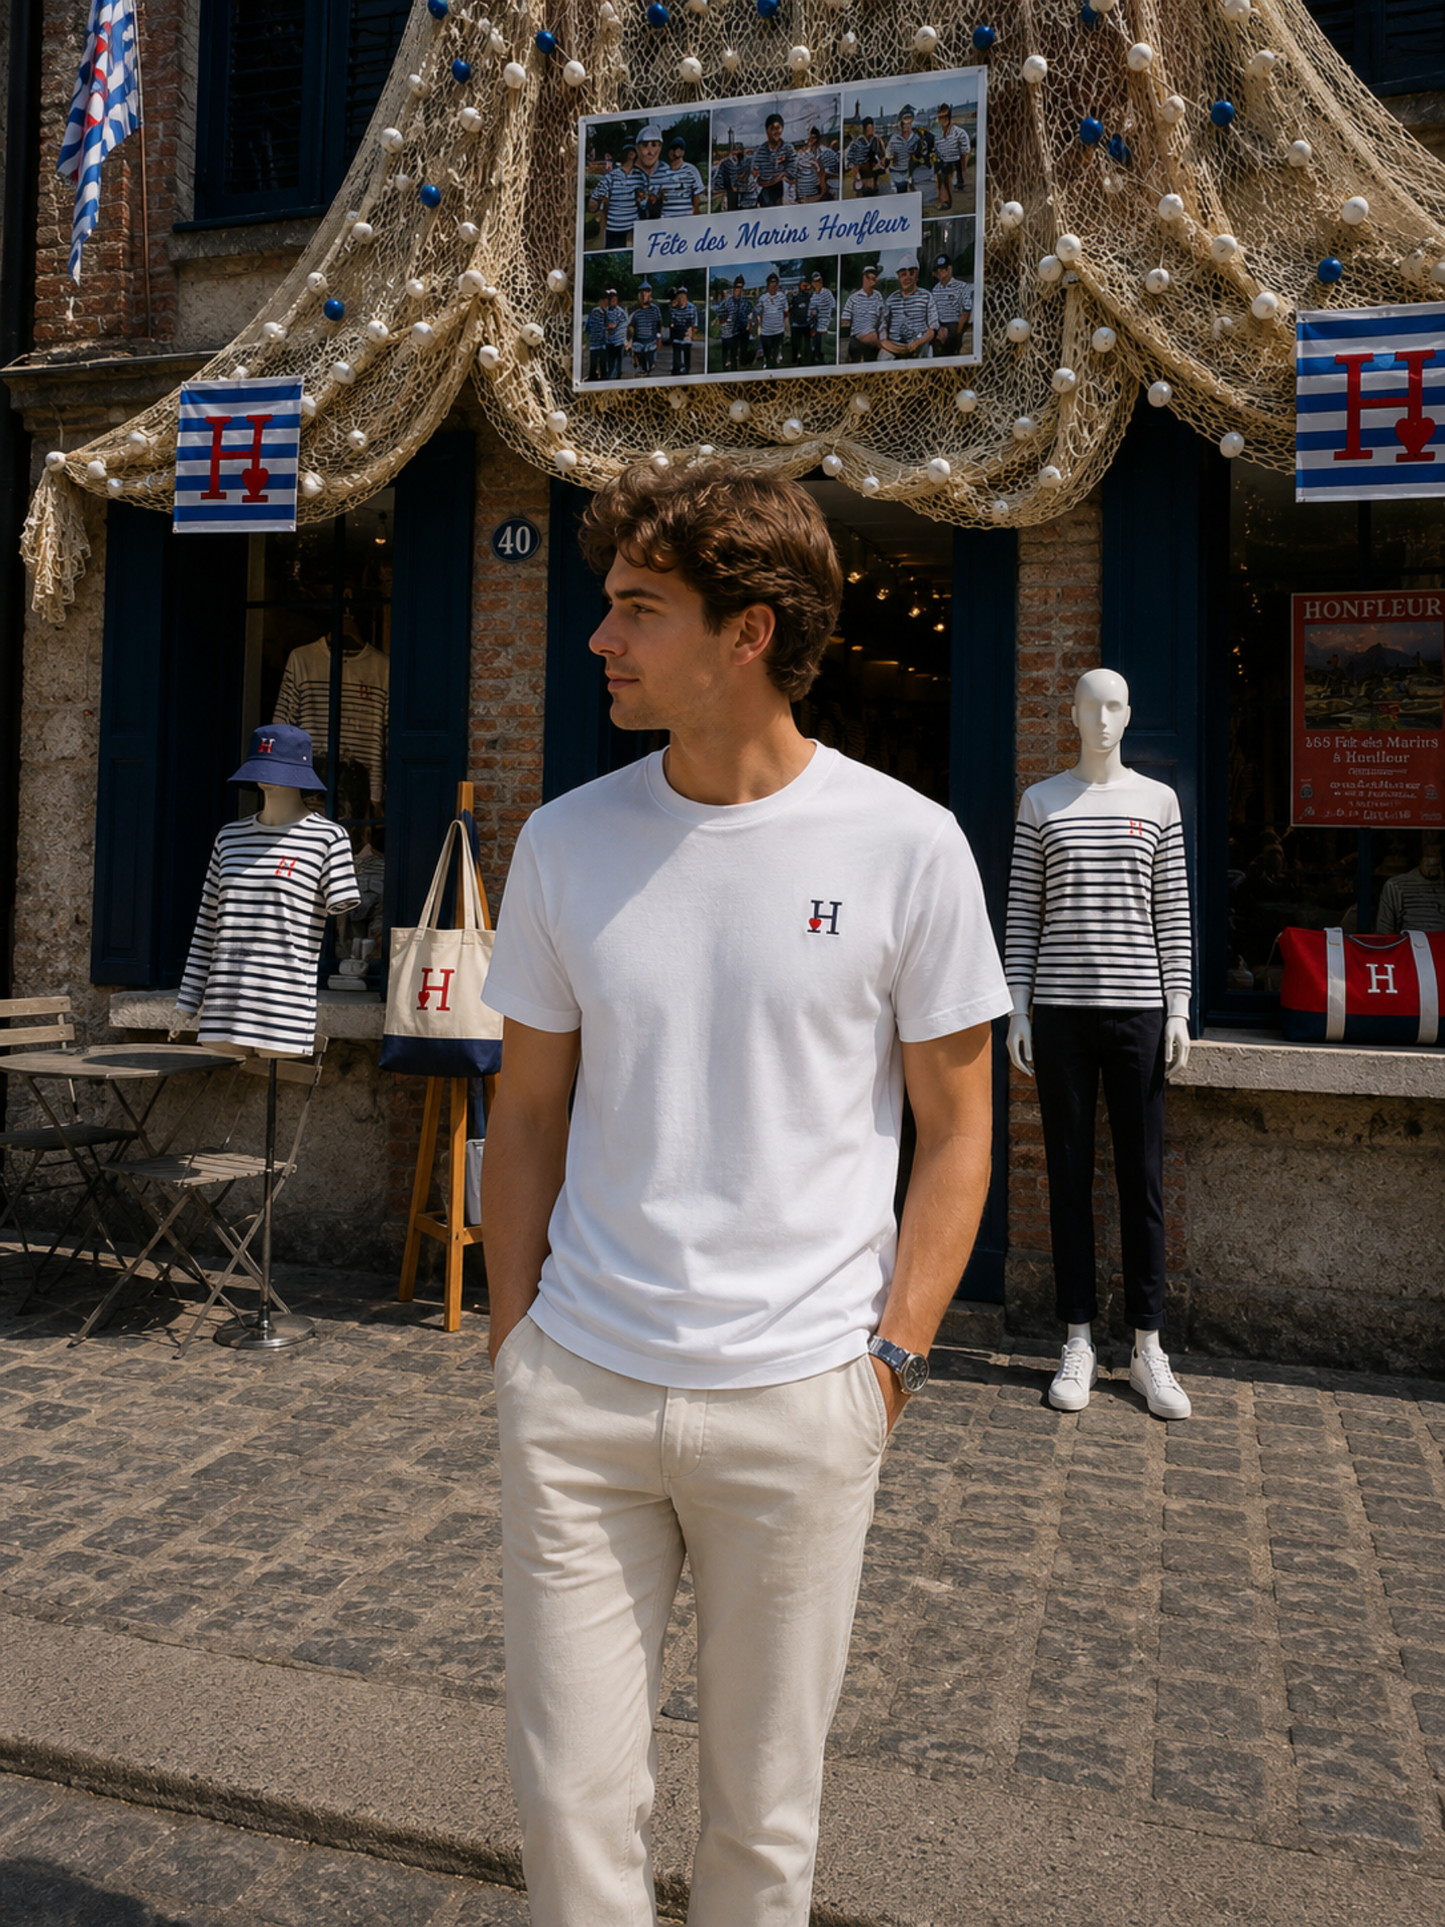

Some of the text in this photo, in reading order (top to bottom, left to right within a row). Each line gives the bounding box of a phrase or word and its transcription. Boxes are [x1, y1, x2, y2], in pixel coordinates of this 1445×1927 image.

[647, 209, 911, 258] Fête des Marins Honfleur
[1333, 349, 1436, 463] H
[200, 413, 274, 504] H
[498, 525, 531, 555] 40
[1302, 597, 1443, 620] HONFLEUR
[258, 737, 276, 754] H
[807, 899, 843, 936] H
[416, 967, 455, 1012] H
[1365, 963, 1398, 994] H
